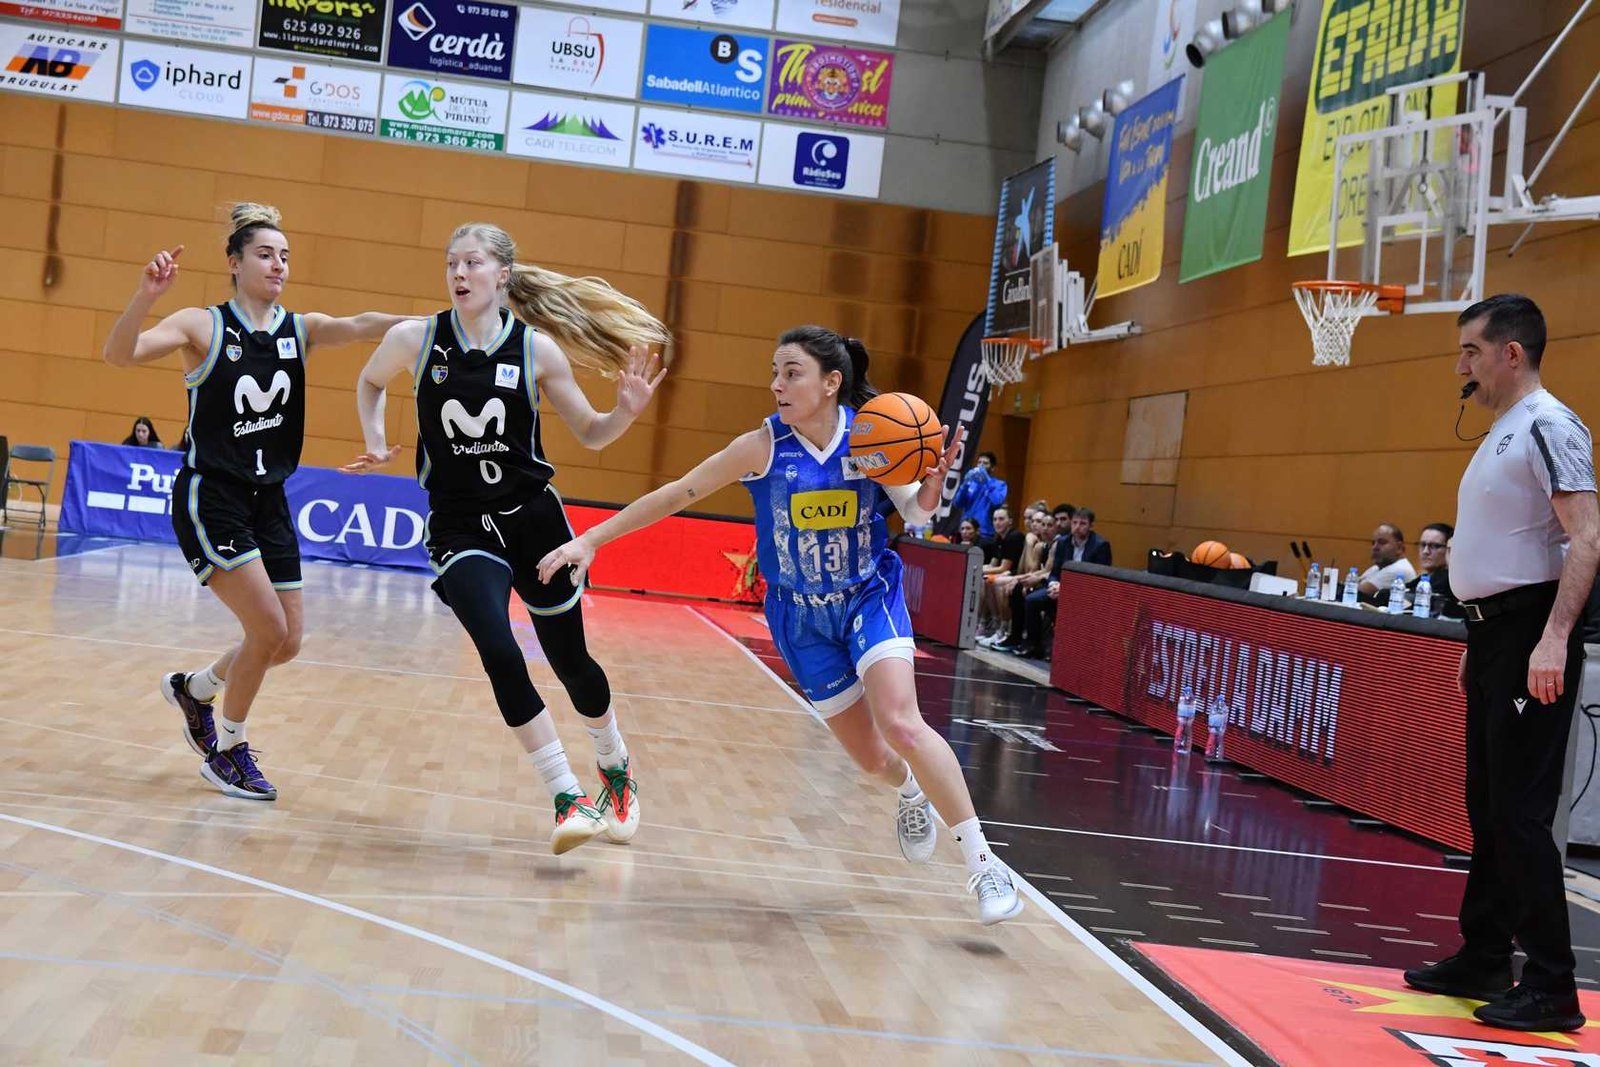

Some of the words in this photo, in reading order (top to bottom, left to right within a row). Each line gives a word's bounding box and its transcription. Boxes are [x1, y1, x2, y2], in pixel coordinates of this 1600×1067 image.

[283, 18, 308, 32] 625
[310, 23, 335, 37] 492
[337, 26, 362, 40] 926
[27, 33, 109, 51] AUTOCARS
[429, 32, 506, 61] cerdà
[552, 41, 595, 59] UBSU
[165, 61, 242, 90] iphard
[310, 82, 361, 100] GDOS
[308, 112, 322, 126] Tel.
[323, 115, 340, 128] 973
[341, 119, 357, 131] 350
[358, 121, 375, 133] 075
[389, 127, 412, 140] Tel.
[416, 131, 440, 144] 973
[472, 139, 496, 151] 290
[668, 130, 754, 151] S.U.R.E.M
[256, 448, 268, 476] 1
[801, 502, 848, 519] CADÍ
[299, 499, 425, 549] CAD
[807, 540, 842, 577] 13
[1147, 620, 1250, 728] ESTRELLA
[1251, 647, 1343, 761] DAMM
